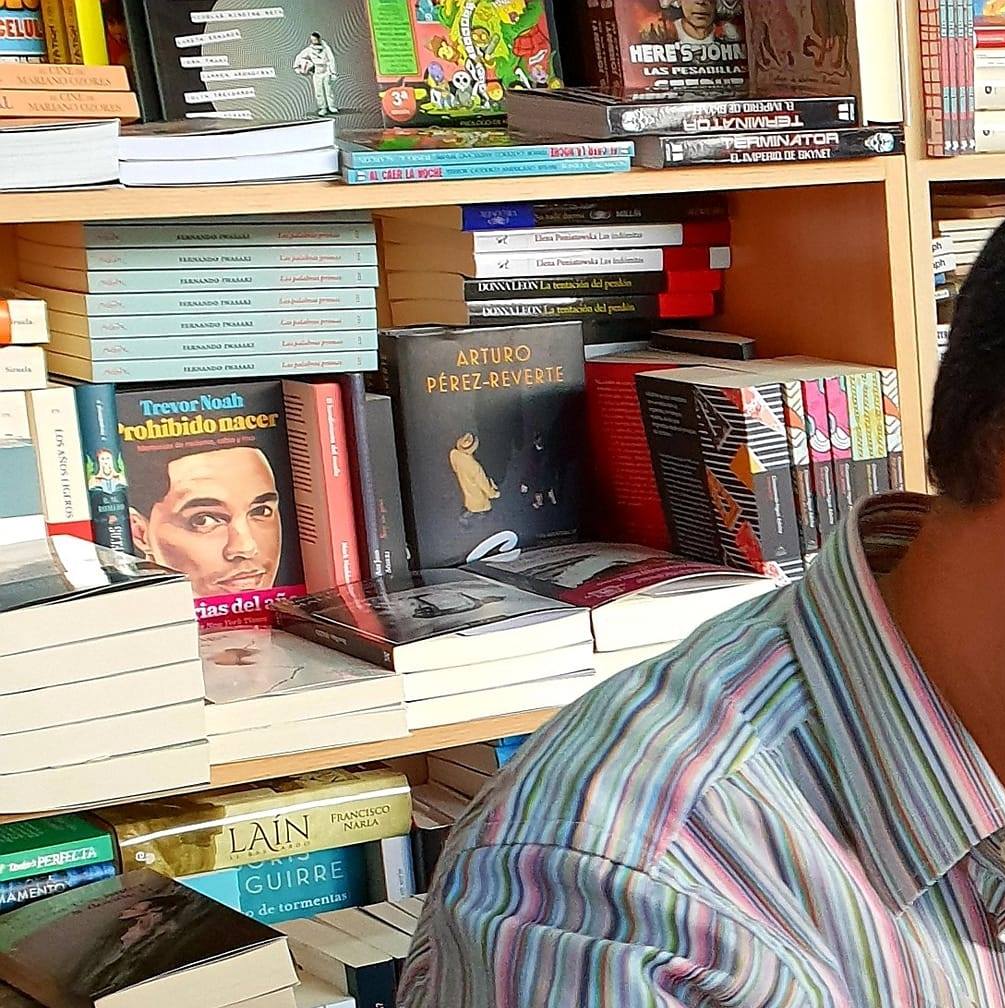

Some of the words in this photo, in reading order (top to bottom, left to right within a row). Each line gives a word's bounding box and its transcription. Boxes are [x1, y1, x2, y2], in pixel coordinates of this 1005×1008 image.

[629, 41, 693, 63] HERE'S
[643, 67, 669, 75] LAS
[683, 113, 804, 130] TERMINATOR
[724, 132, 839, 149] TERMINATOR
[417, 167, 443, 178] NOCHE
[535, 234, 554, 242] Elena
[555, 232, 598, 242] Poniatowska
[536, 258, 555, 267] Elena
[556, 256, 599, 267] Poniatowska
[457, 345, 531, 367] ARTURO
[183, 365, 223, 373] FERNANDO
[427, 366, 565, 394] PÉREZ-REVERTE
[140, 399, 199, 417] Trevor
[200, 391, 244, 411] Noah
[118, 414, 218, 442] rohibido
[218, 411, 279, 436] nacer
[231, 595, 262, 614] del
[330, 804, 391, 824] FRANCISCO
[229, 814, 311, 854] LAÍN
[343, 818, 380, 832] NARLA
[37, 846, 98, 869] PERFECTA
[245, 861, 345, 895] GUIRRE
[258, 904, 276, 918] de
[278, 890, 349, 913] tormentas
